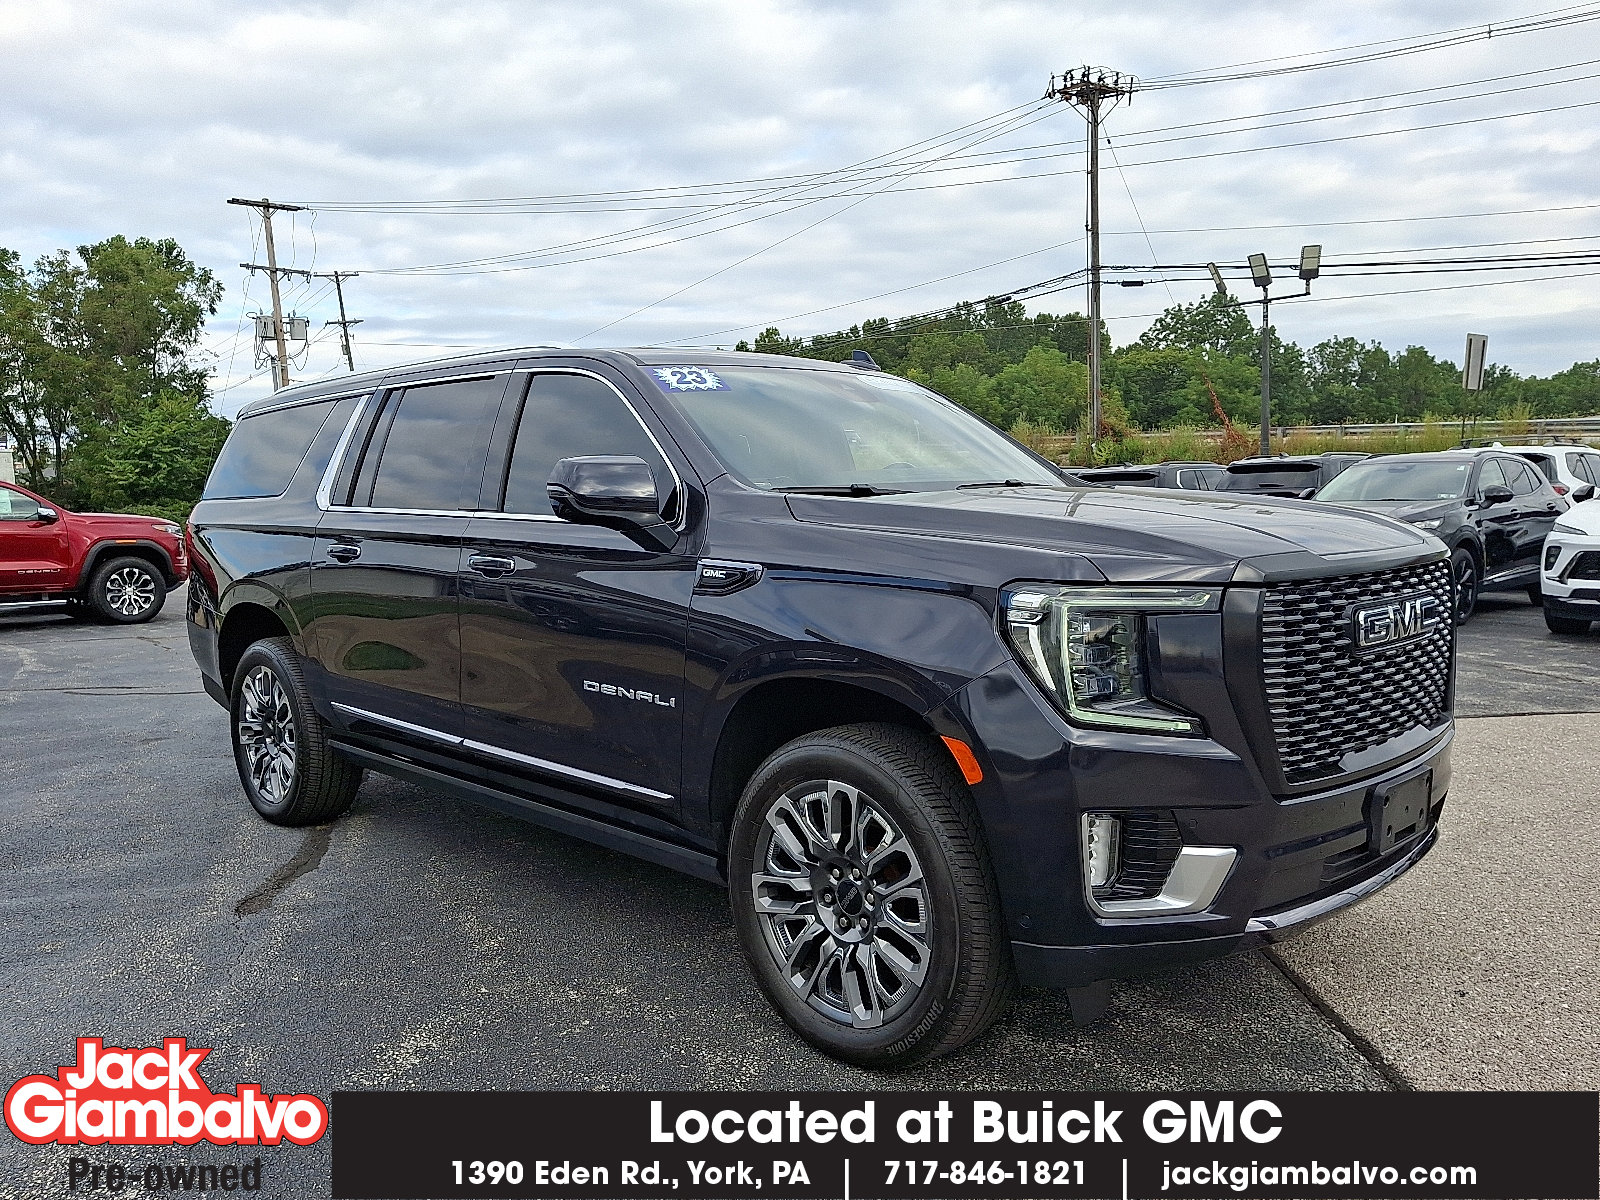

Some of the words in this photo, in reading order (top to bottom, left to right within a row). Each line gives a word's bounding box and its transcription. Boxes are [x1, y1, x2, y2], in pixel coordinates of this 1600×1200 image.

[670, 370, 708, 385] 23
[702, 568, 726, 578] GMC
[1358, 596, 1440, 647] GMC
[583, 679, 676, 708] DENALI
[885, 999, 944, 1057] BRIDGESTONE
